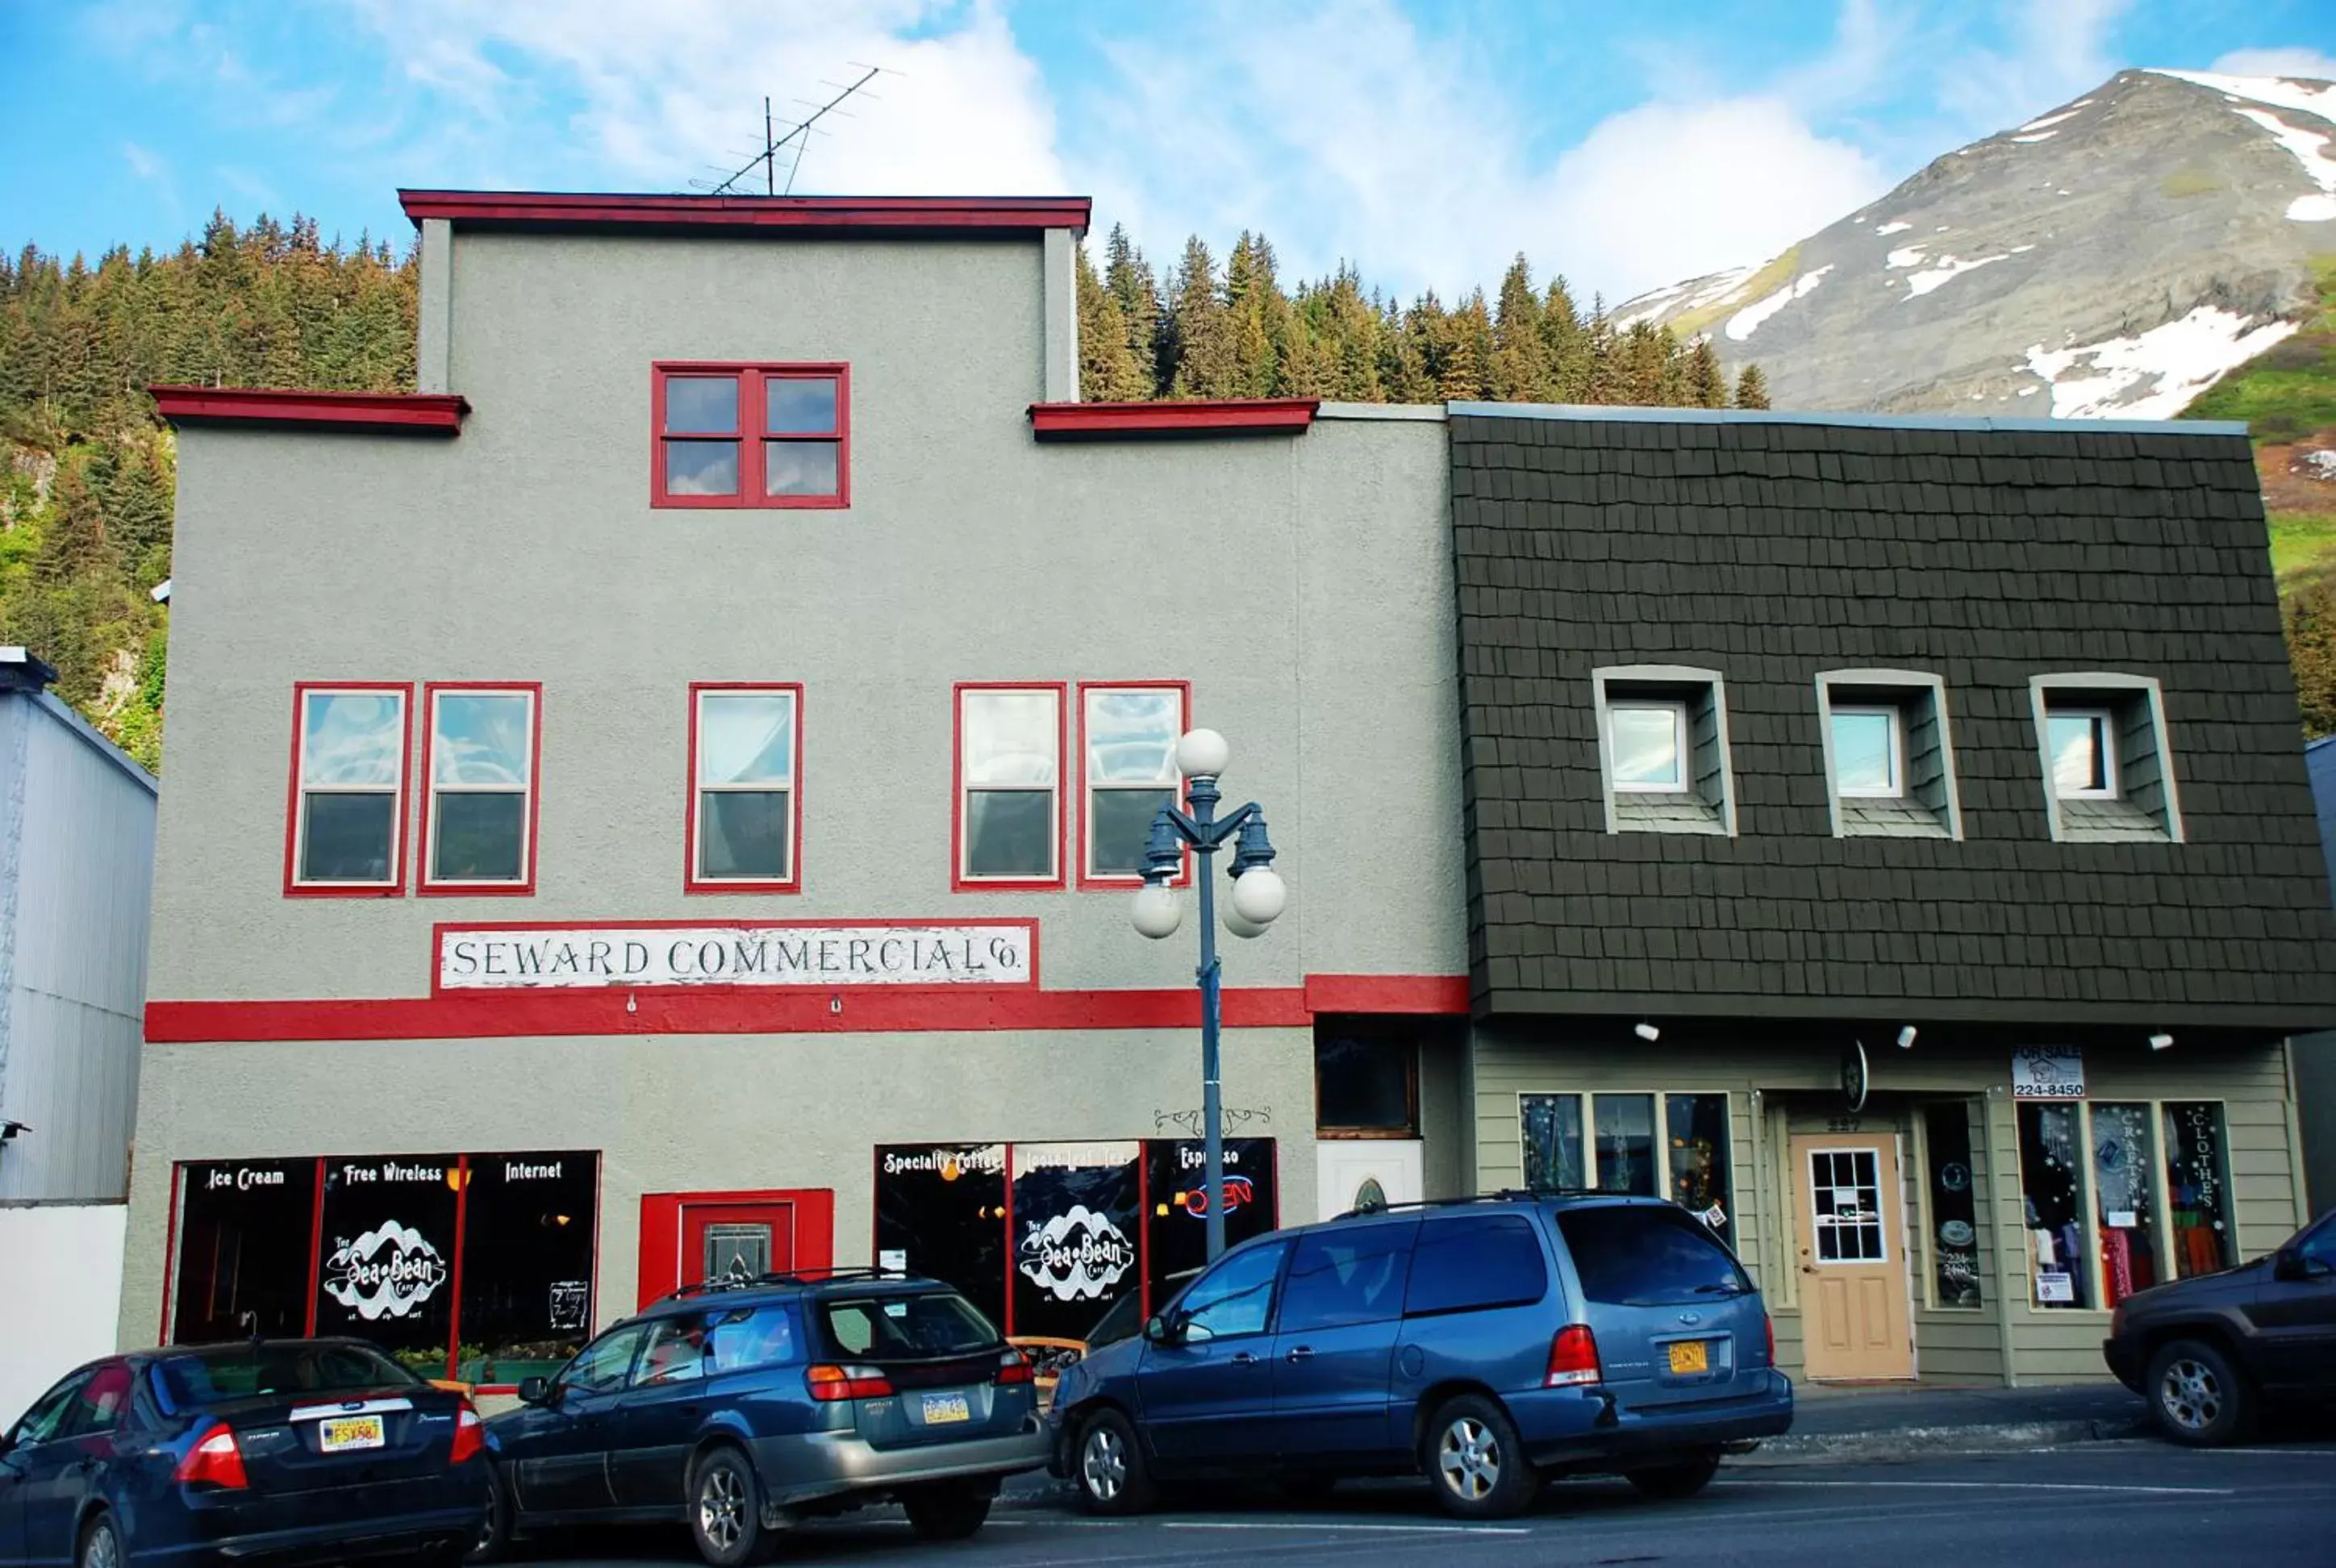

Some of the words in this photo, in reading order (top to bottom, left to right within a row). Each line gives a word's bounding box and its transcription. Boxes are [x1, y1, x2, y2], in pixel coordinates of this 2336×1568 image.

[453, 939, 649, 975] SEWARD
[668, 939, 985, 974] COMMERCIAL
[2046, 1045, 2081, 1058] SALE
[2017, 1085, 2083, 1095] 224-8450
[505, 1161, 561, 1182] Internet
[884, 1153, 950, 1174] Specialty
[2192, 1112, 2213, 1207] CLOTHES
[207, 1168, 234, 1190] Ice
[238, 1166, 285, 1191] Cream
[344, 1164, 377, 1185] Free
[383, 1161, 442, 1182] Wireless
[1186, 1182, 1252, 1212] OEN
[1041, 1236, 1072, 1267] Sea
[1081, 1233, 1122, 1265] Bean
[348, 1252, 380, 1285] Sea
[390, 1250, 432, 1282] Bean
